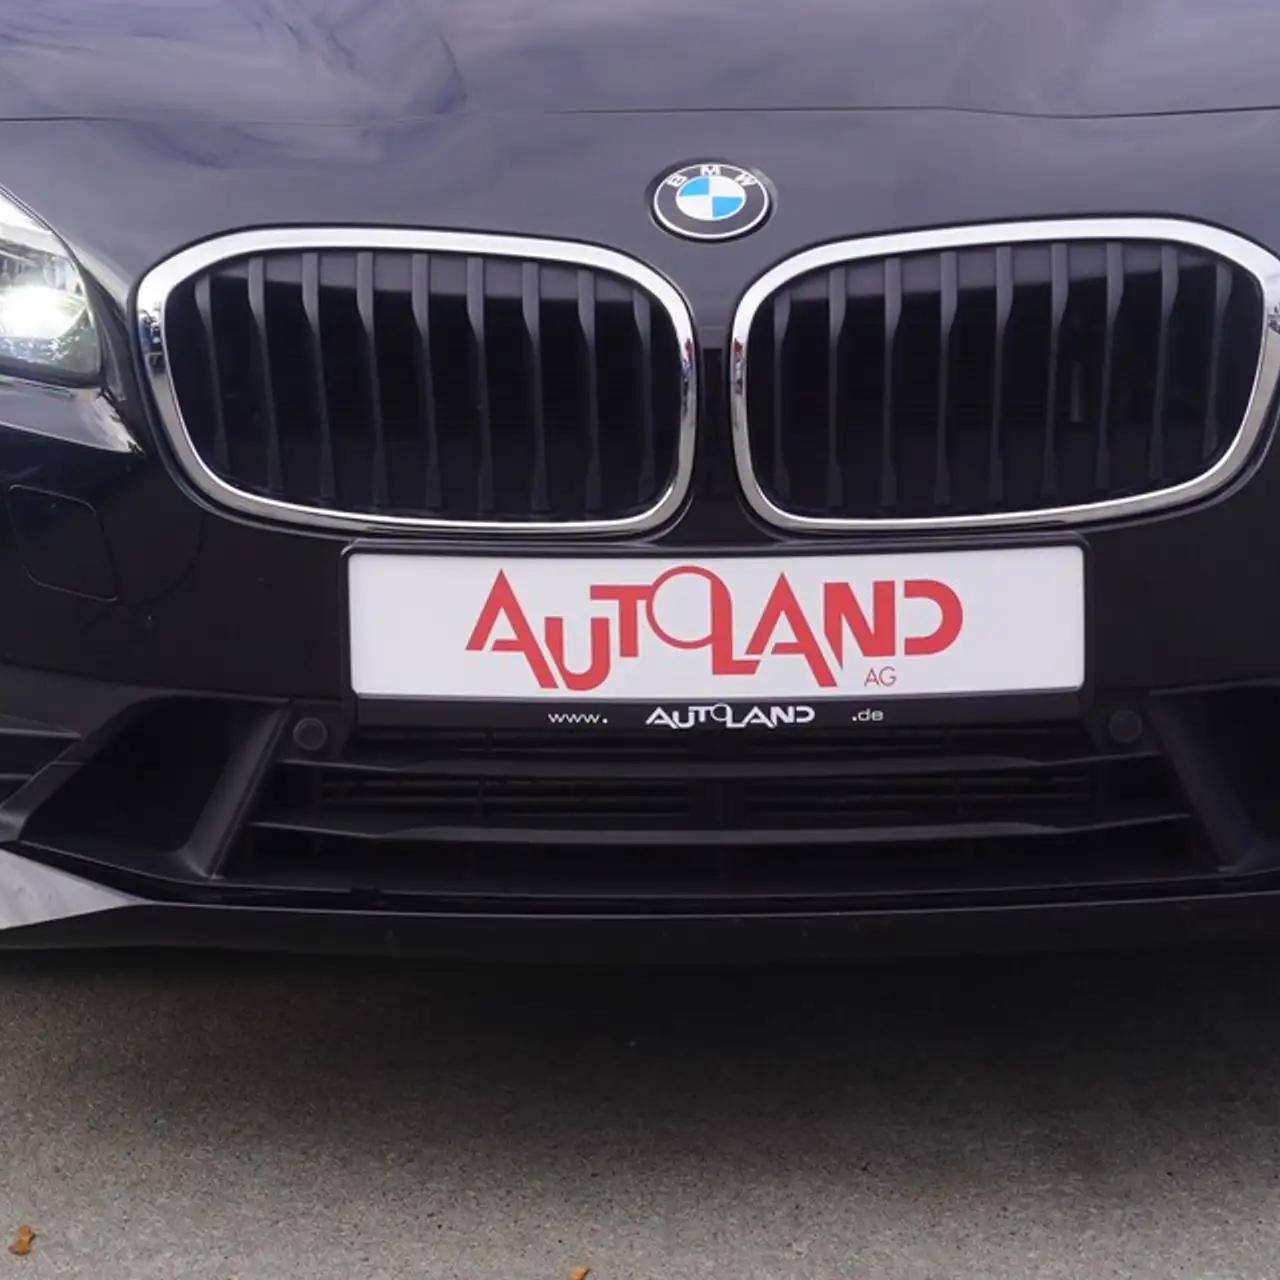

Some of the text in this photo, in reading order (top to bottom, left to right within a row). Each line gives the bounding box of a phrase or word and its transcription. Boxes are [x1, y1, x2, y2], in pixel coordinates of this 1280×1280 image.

[667, 164, 757, 188] BMW
[465, 565, 964, 691] AUTOLAND
[863, 667, 897, 687] AG
[547, 702, 885, 729] www. AUTOLAND .de
